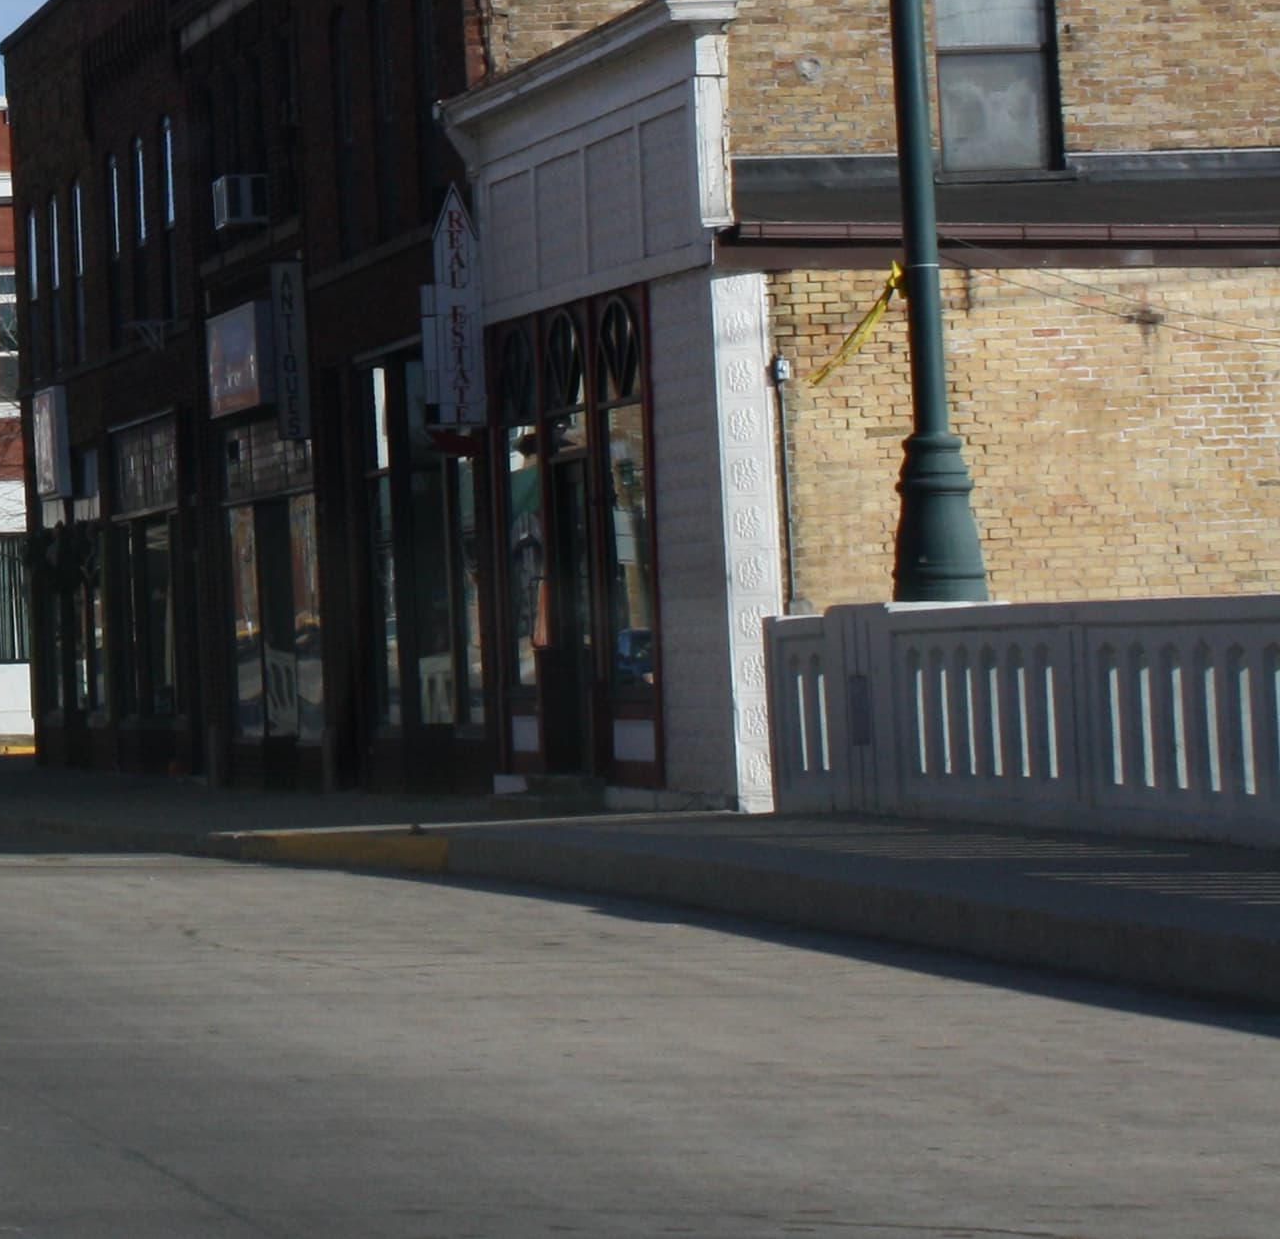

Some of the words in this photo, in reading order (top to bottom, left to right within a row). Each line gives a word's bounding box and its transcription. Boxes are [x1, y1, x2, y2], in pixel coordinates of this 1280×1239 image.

[447, 210, 467, 290] REAL
[280, 271, 302, 436] ANTIQUES
[451, 305, 472, 423] ESTATE
